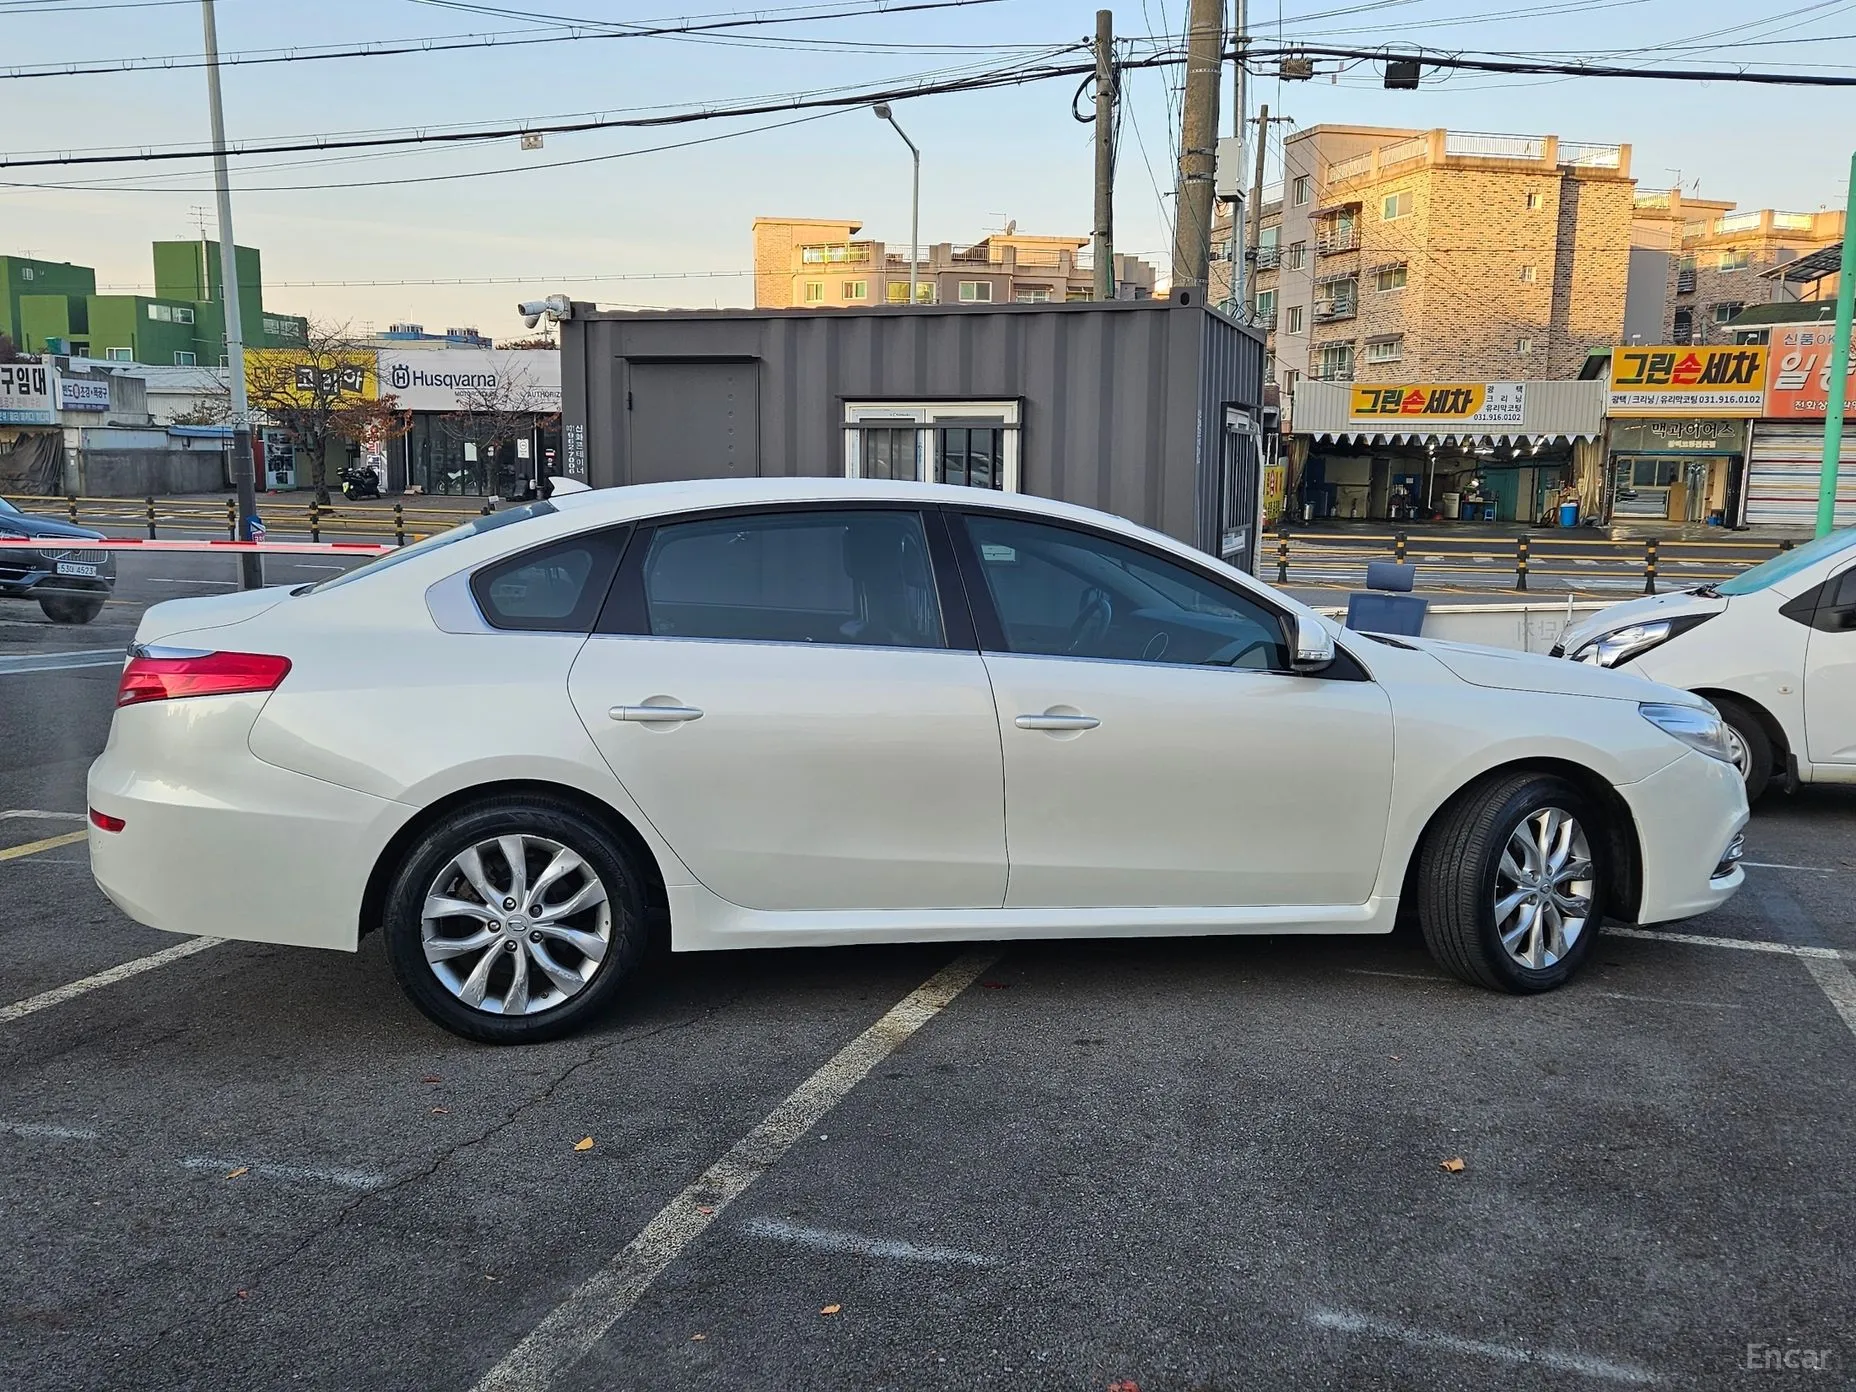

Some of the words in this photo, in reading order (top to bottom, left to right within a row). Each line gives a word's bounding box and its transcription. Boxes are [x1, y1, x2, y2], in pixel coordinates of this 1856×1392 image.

[1615, 351, 1760, 385] 그린손세차
[1, 367, 47, 395] 구임대
[412, 370, 496, 389] Husqvarna
[1355, 389, 1473, 414] 그린손세차
[1699, 395, 1761, 404] 031.916.0102
[1473, 413, 1521, 421] 031.916.0102
